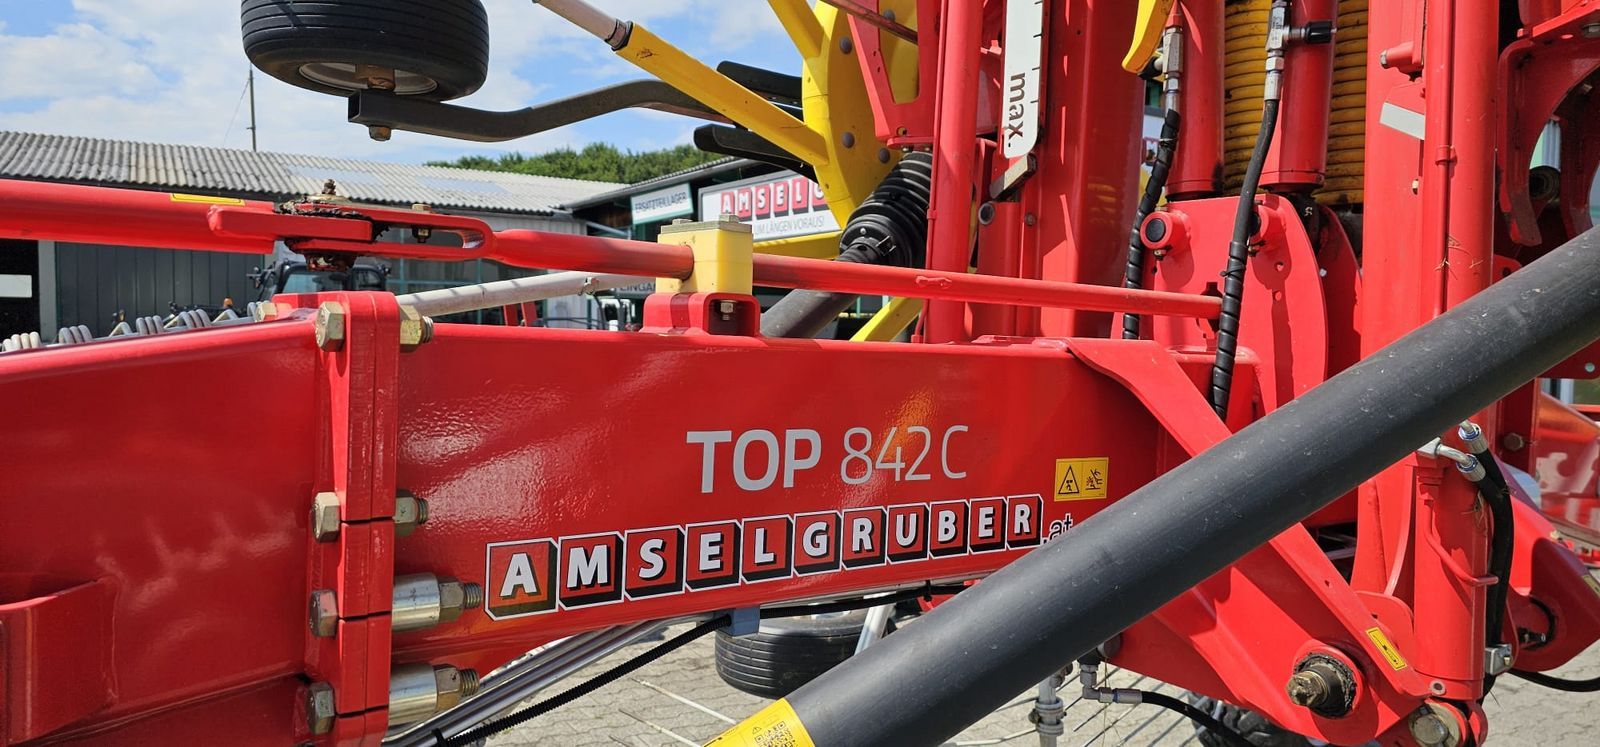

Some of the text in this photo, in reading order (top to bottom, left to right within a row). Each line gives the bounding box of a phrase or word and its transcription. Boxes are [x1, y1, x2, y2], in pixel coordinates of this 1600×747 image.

[1008, 72, 1025, 148] max.
[634, 192, 687, 211] ERSATZTEILLAGER
[686, 429, 822, 493] TOP
